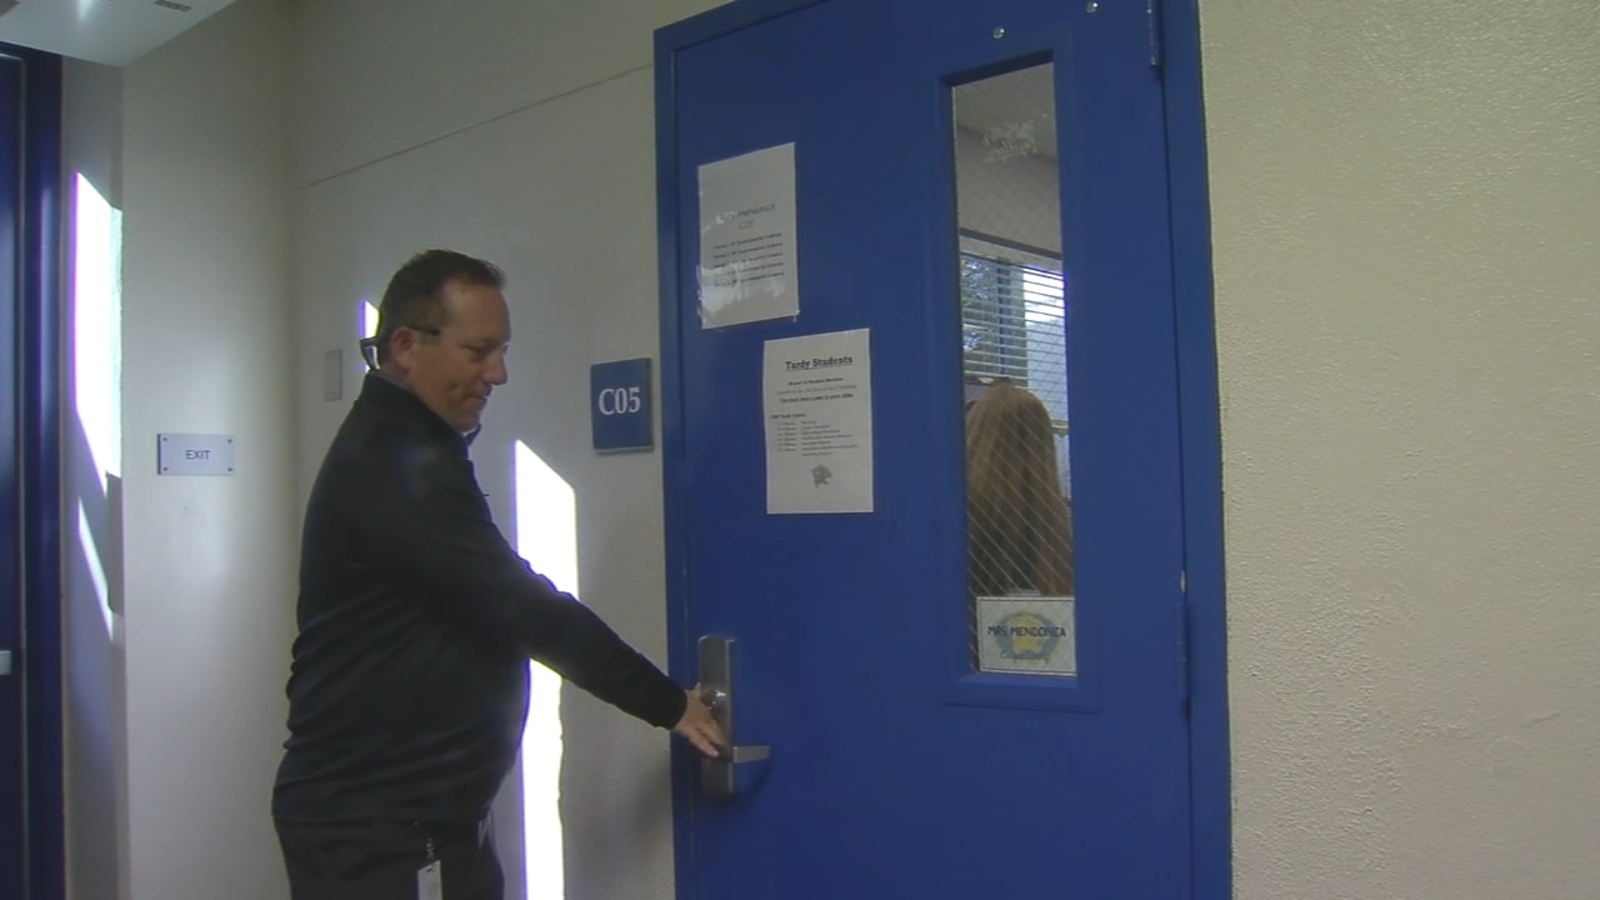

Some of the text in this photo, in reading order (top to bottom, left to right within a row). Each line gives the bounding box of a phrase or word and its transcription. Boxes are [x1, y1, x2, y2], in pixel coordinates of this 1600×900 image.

[786, 356, 853, 371] Tardy Students
[598, 387, 641, 416] C05
[186, 449, 211, 460] EXIT
